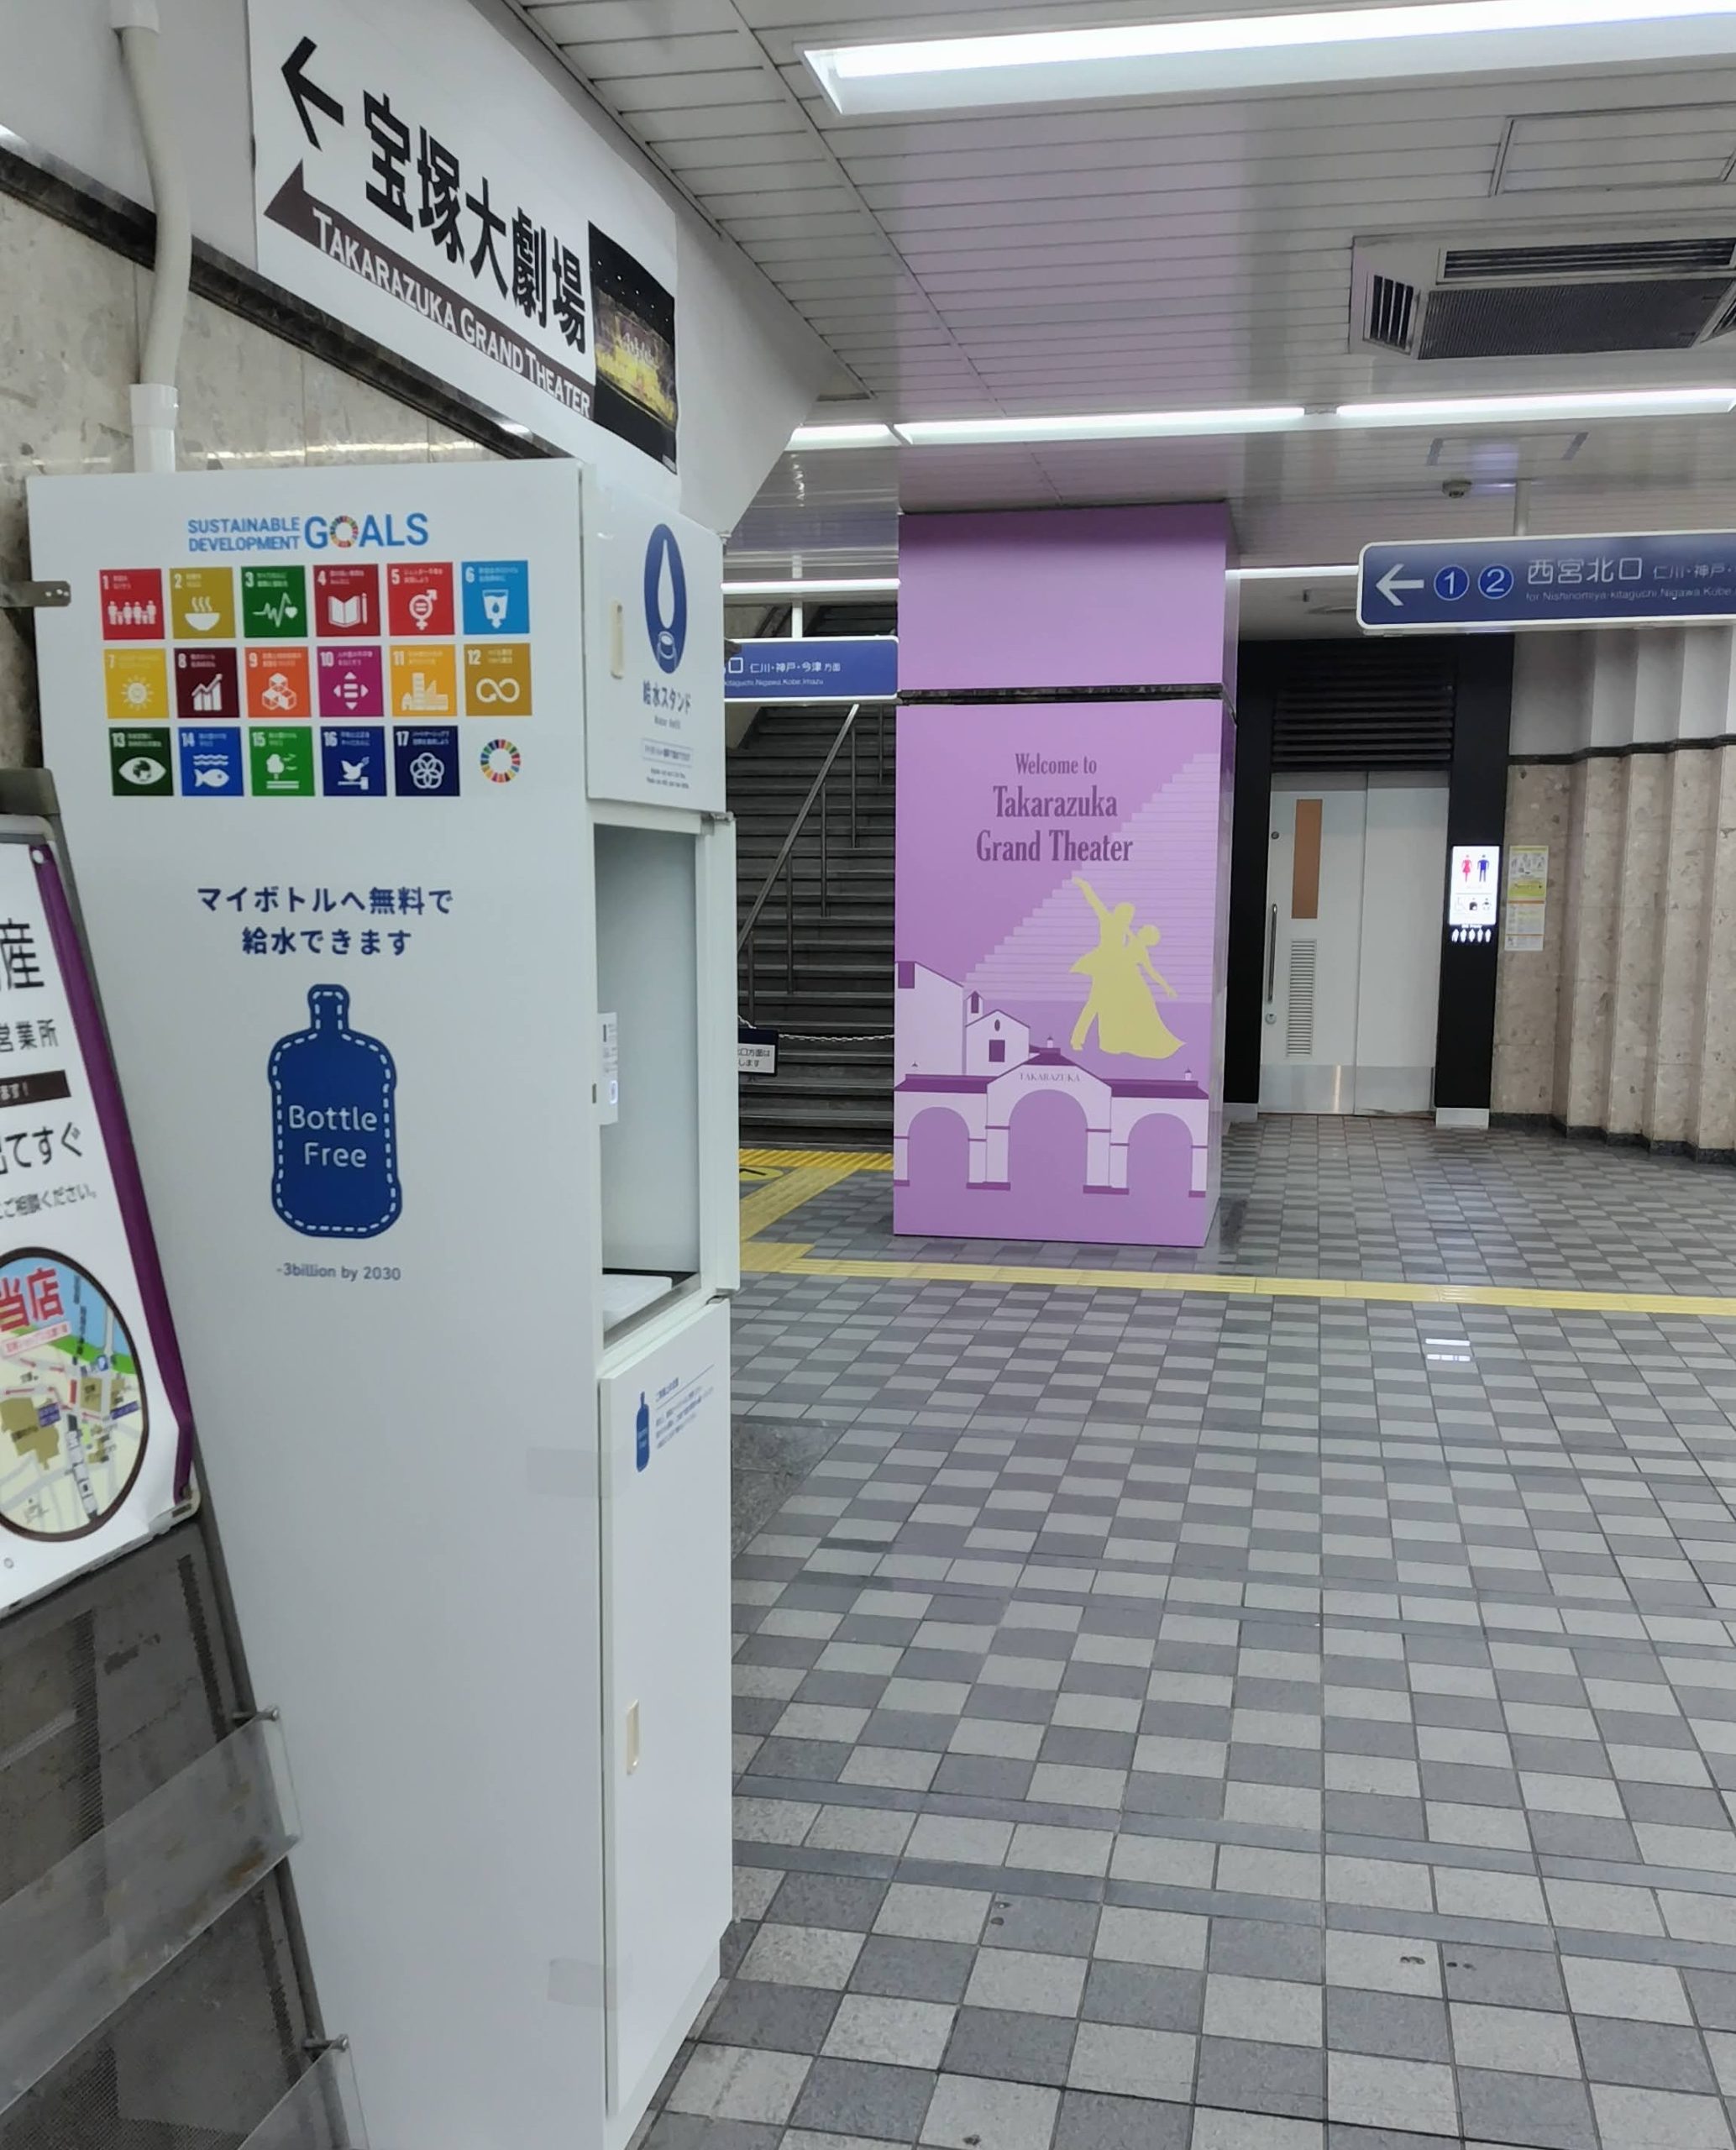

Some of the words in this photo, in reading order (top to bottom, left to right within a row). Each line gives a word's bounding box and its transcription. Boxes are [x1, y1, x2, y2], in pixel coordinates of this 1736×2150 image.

[363, 90, 586, 354] 宝塚大劇場
[312, 207, 457, 333] TAKARAZUKA
[460, 307, 524, 375] GRAND
[525, 349, 590, 418] THEATER
[188, 517, 300, 534] SUSTAINABLE
[304, 512, 429, 549] GOALS
[189, 535, 300, 552] DEVELOPMENT
[245, 571, 254, 587] 3
[317, 570, 327, 586] 4
[391, 568, 400, 585] 5
[465, 567, 475, 583] 6
[1527, 557, 1643, 585] 西宮北口
[102, 574, 109, 590] 1
[174, 573, 182, 589] 2
[108, 654, 116, 669] 7
[178, 653, 186, 669] 8
[249, 653, 258, 668] 9
[320, 651, 334, 667] 10
[392, 650, 405, 666] 11
[467, 649, 480, 665] 12
[724, 657, 744, 674] 口
[112, 732, 126, 747] 13
[181, 732, 194, 747] 14
[252, 732, 266, 747] 15
[323, 732, 338, 747] 16
[396, 731, 410, 747] 17
[1015, 752, 1078, 774] Welcome
[1083, 756, 1097, 774] to
[993, 784, 1118, 817] Takarazuka
[976, 829, 1041, 862] Grand
[1048, 829, 1133, 862] Theater
[197, 886, 454, 915] マイボトルへ無料で
[241, 926, 412, 956] 給水できます
[738, 1047, 770, 1057] 口方面は
[288, 1104, 378, 1131] Bottle
[304, 1141, 367, 1167] Free
[0, 1183, 97, 1219] ご相談ください。
[340, 1265, 358, 1282] by
[363, 1266, 401, 1280] 2030
[0, 1267, 64, 1332] 当店
